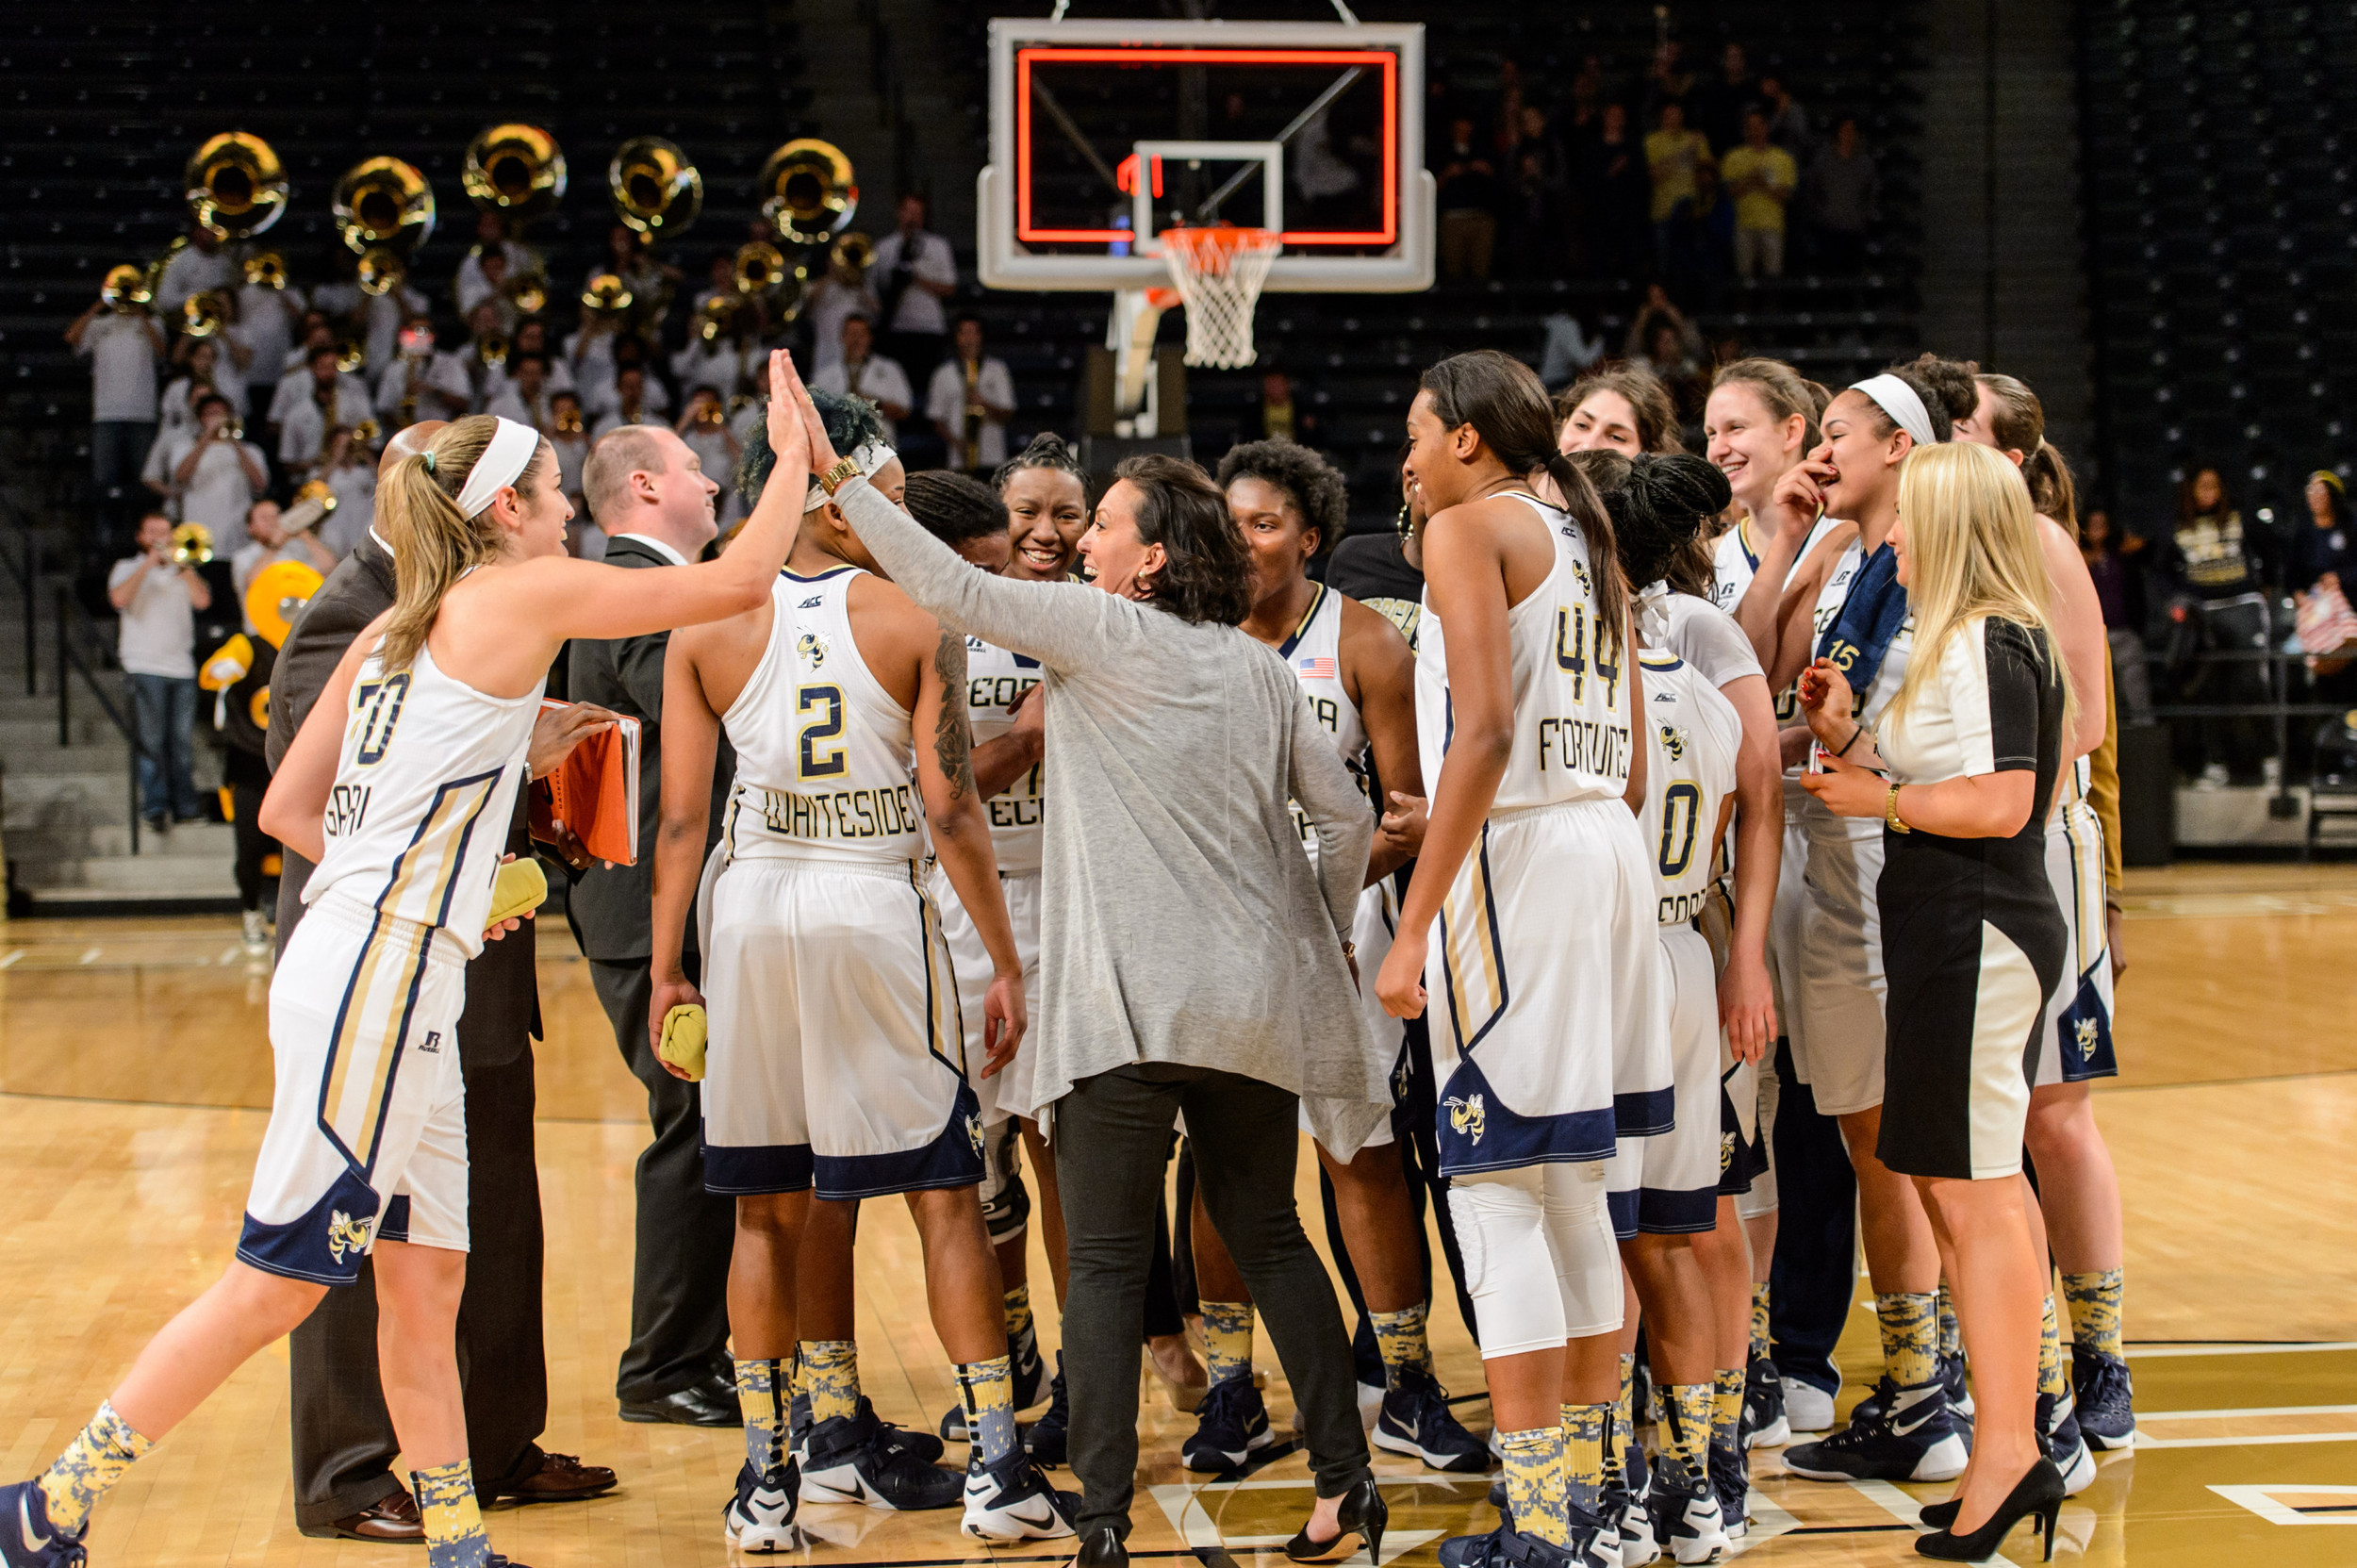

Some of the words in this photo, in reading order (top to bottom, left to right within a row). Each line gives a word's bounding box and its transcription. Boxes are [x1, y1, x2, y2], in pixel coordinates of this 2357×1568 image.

[797, 595, 823, 608] ACC
[1556, 602, 1622, 714] 44
[1829, 638, 1861, 672] 15
[796, 683, 850, 783] 2
[1539, 718, 1629, 780] FORTUNE
[764, 784, 917, 838] WHITESIDE
[1657, 779, 1704, 882] 0
[425, 1030, 441, 1048] R
